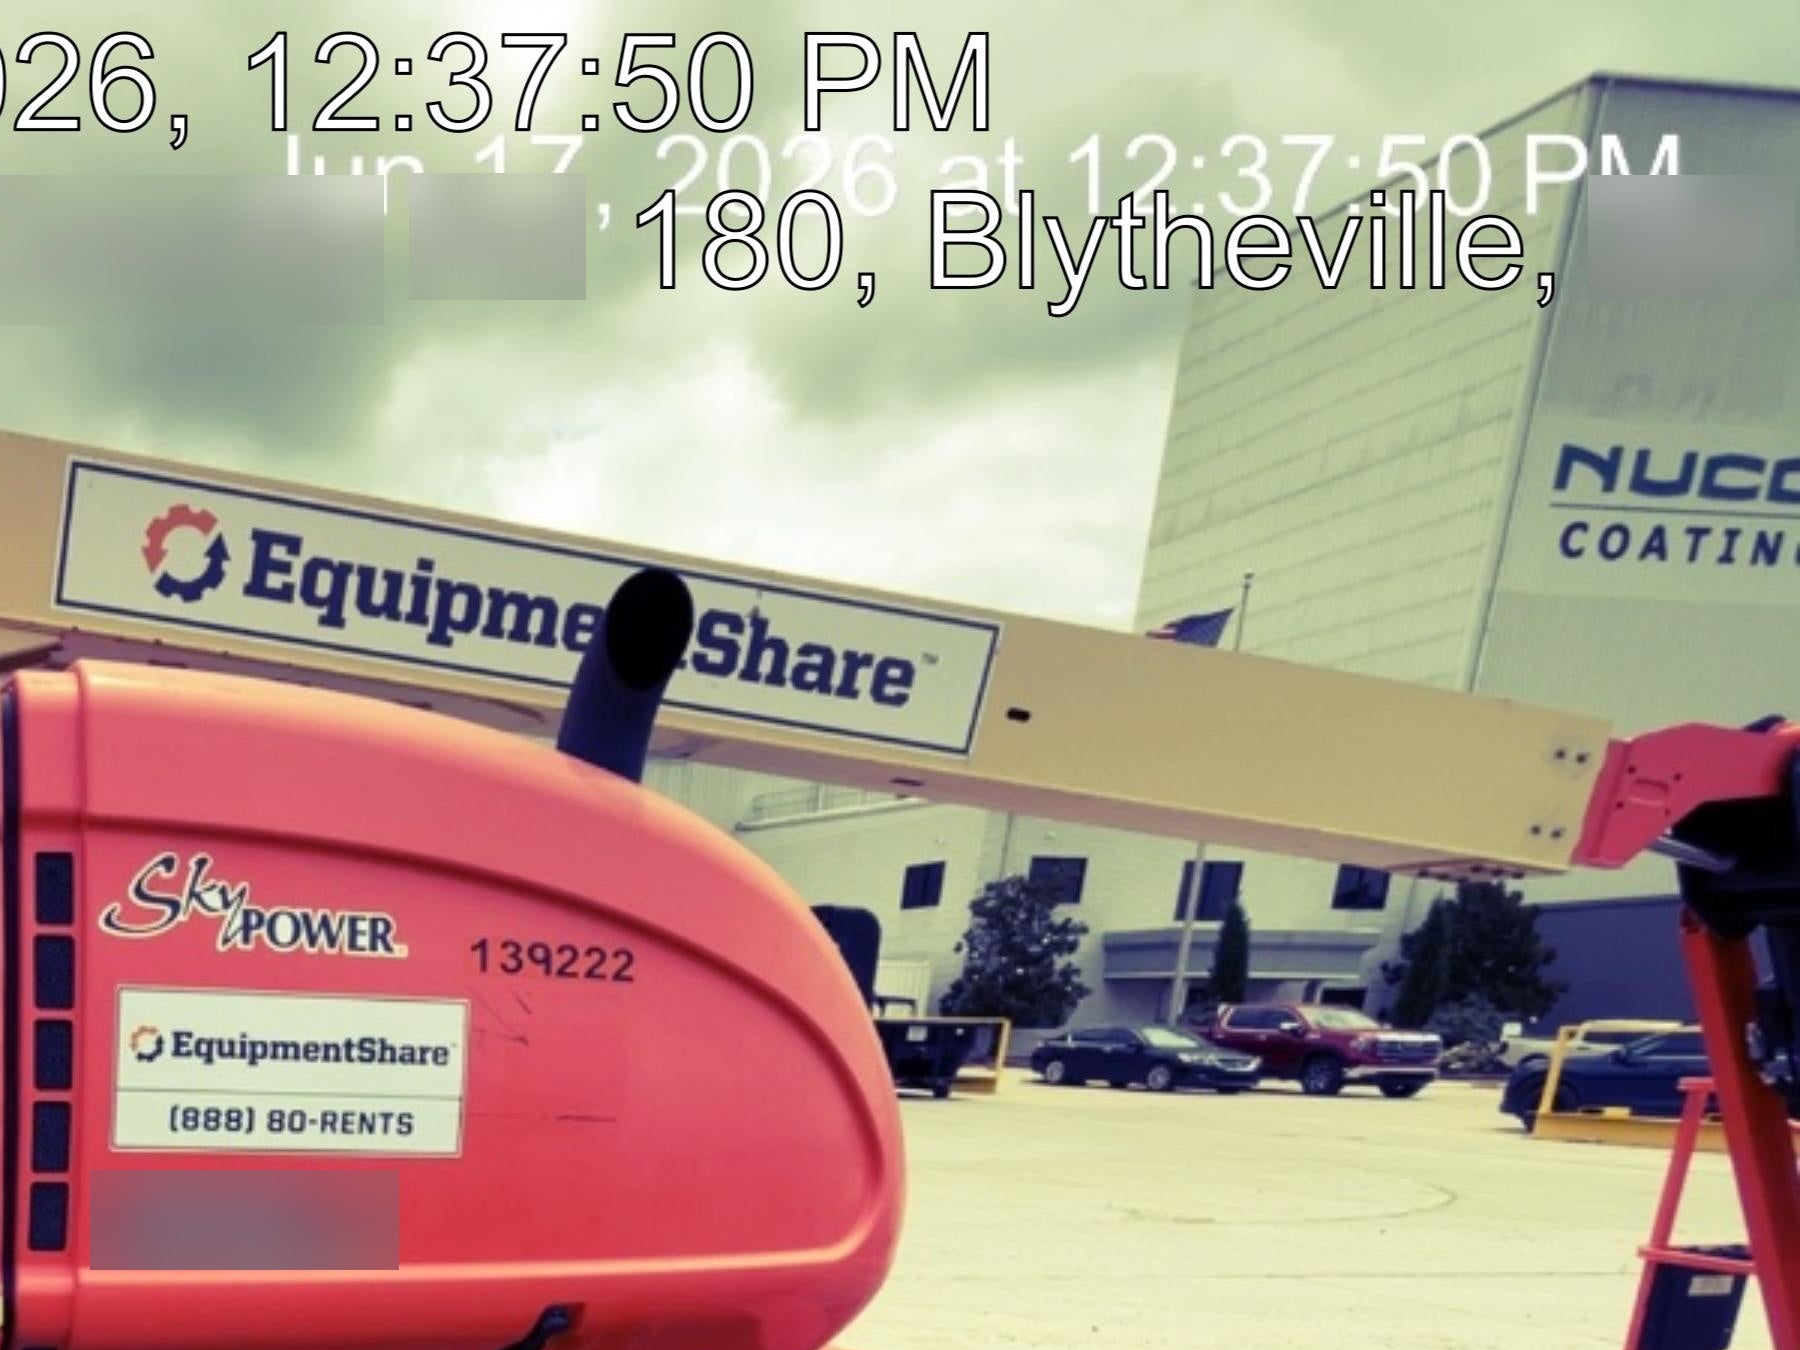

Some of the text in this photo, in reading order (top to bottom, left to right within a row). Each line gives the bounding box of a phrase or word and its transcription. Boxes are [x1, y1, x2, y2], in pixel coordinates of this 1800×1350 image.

[243, 528, 916, 708] EquipmeShare
[471, 938, 635, 982] 139222
[171, 1031, 449, 1067] EquipmentShare
[170, 1104, 414, 1136] (888) 80-RENTS
